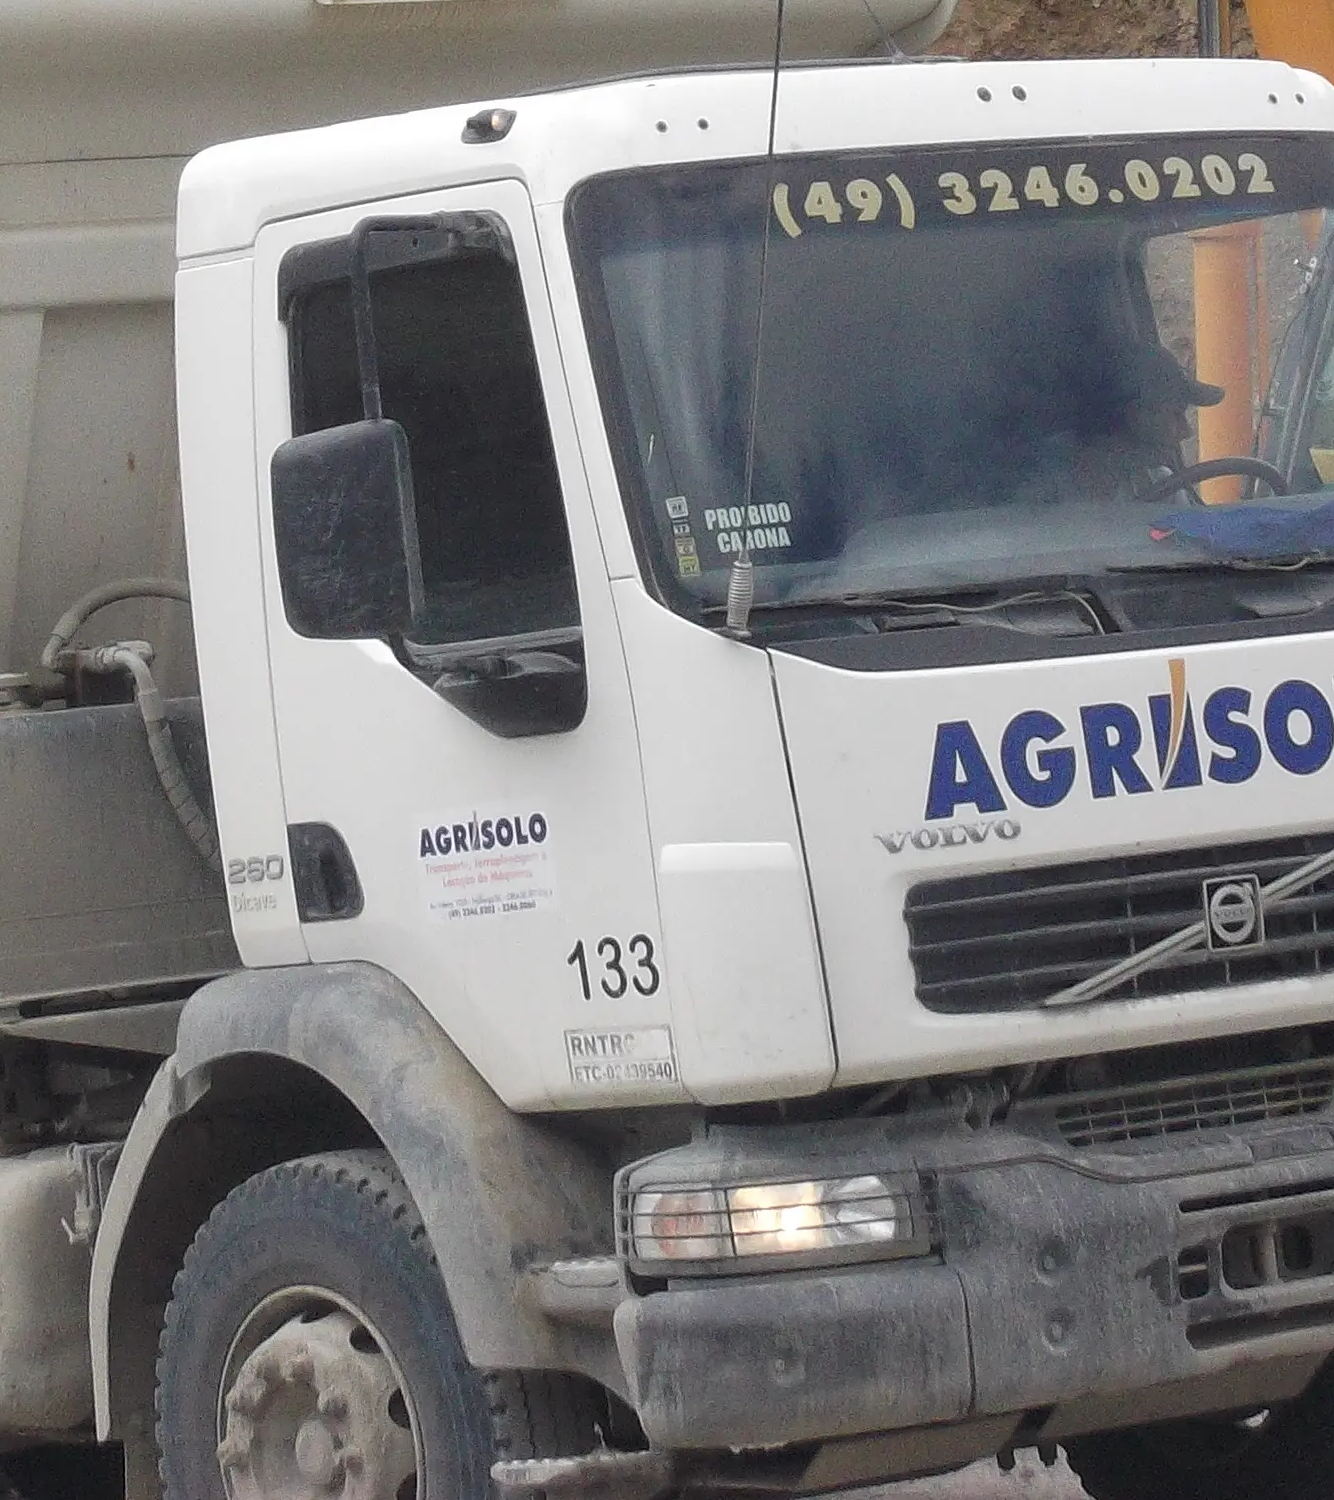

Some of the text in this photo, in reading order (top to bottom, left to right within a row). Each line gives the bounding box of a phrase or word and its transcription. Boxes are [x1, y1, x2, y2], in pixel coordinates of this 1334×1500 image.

[773, 153, 1276, 238] (49) 3246.0202
[420, 810, 547, 858] AGRISOLO
[875, 819, 1022, 855] VOLVO
[567, 934, 660, 1001] 133
